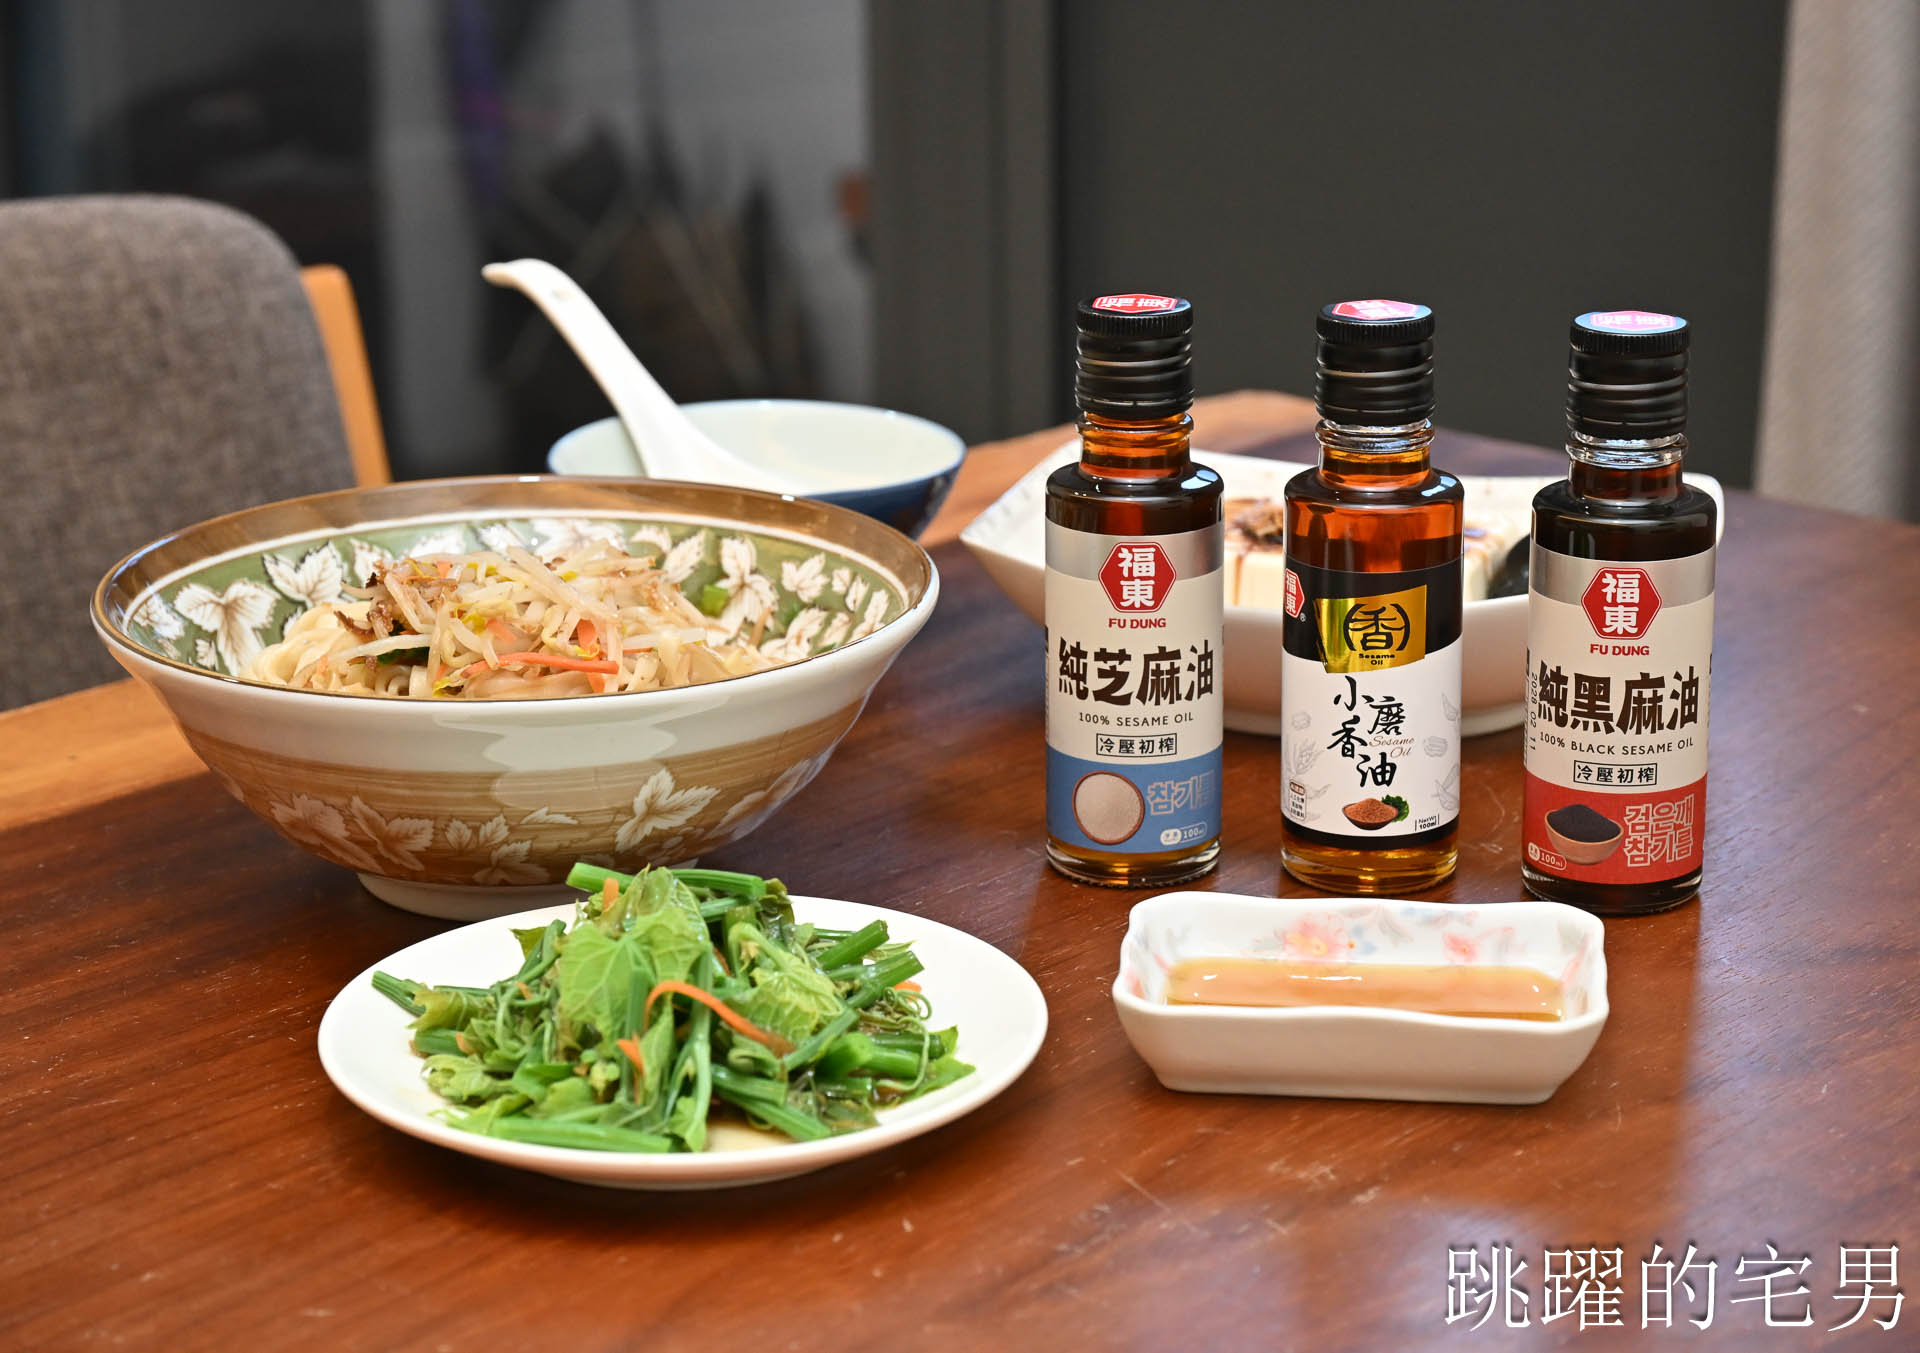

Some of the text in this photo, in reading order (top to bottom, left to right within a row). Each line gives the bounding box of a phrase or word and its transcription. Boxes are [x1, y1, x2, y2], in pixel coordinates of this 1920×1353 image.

[1118, 547, 1156, 608] 福東
[1601, 573, 1641, 635] 福東
[1108, 618, 1167, 629] FU DUNG
[1349, 606, 1405, 651] 香
[1590, 644, 1650, 656] FU DUNG
[1059, 637, 1214, 706] 純芝麻油
[1538, 660, 1699, 735] 純黑麻油
[1079, 712, 1194, 727] 100% SESAME OIL
[1099, 737, 1175, 755] 冷壓初榨
[1540, 731, 1694, 755] 100% BLACK SESAME OIL
[1577, 764, 1656, 784] 冷壓初榨
[1624, 827, 1694, 867] 참기름
